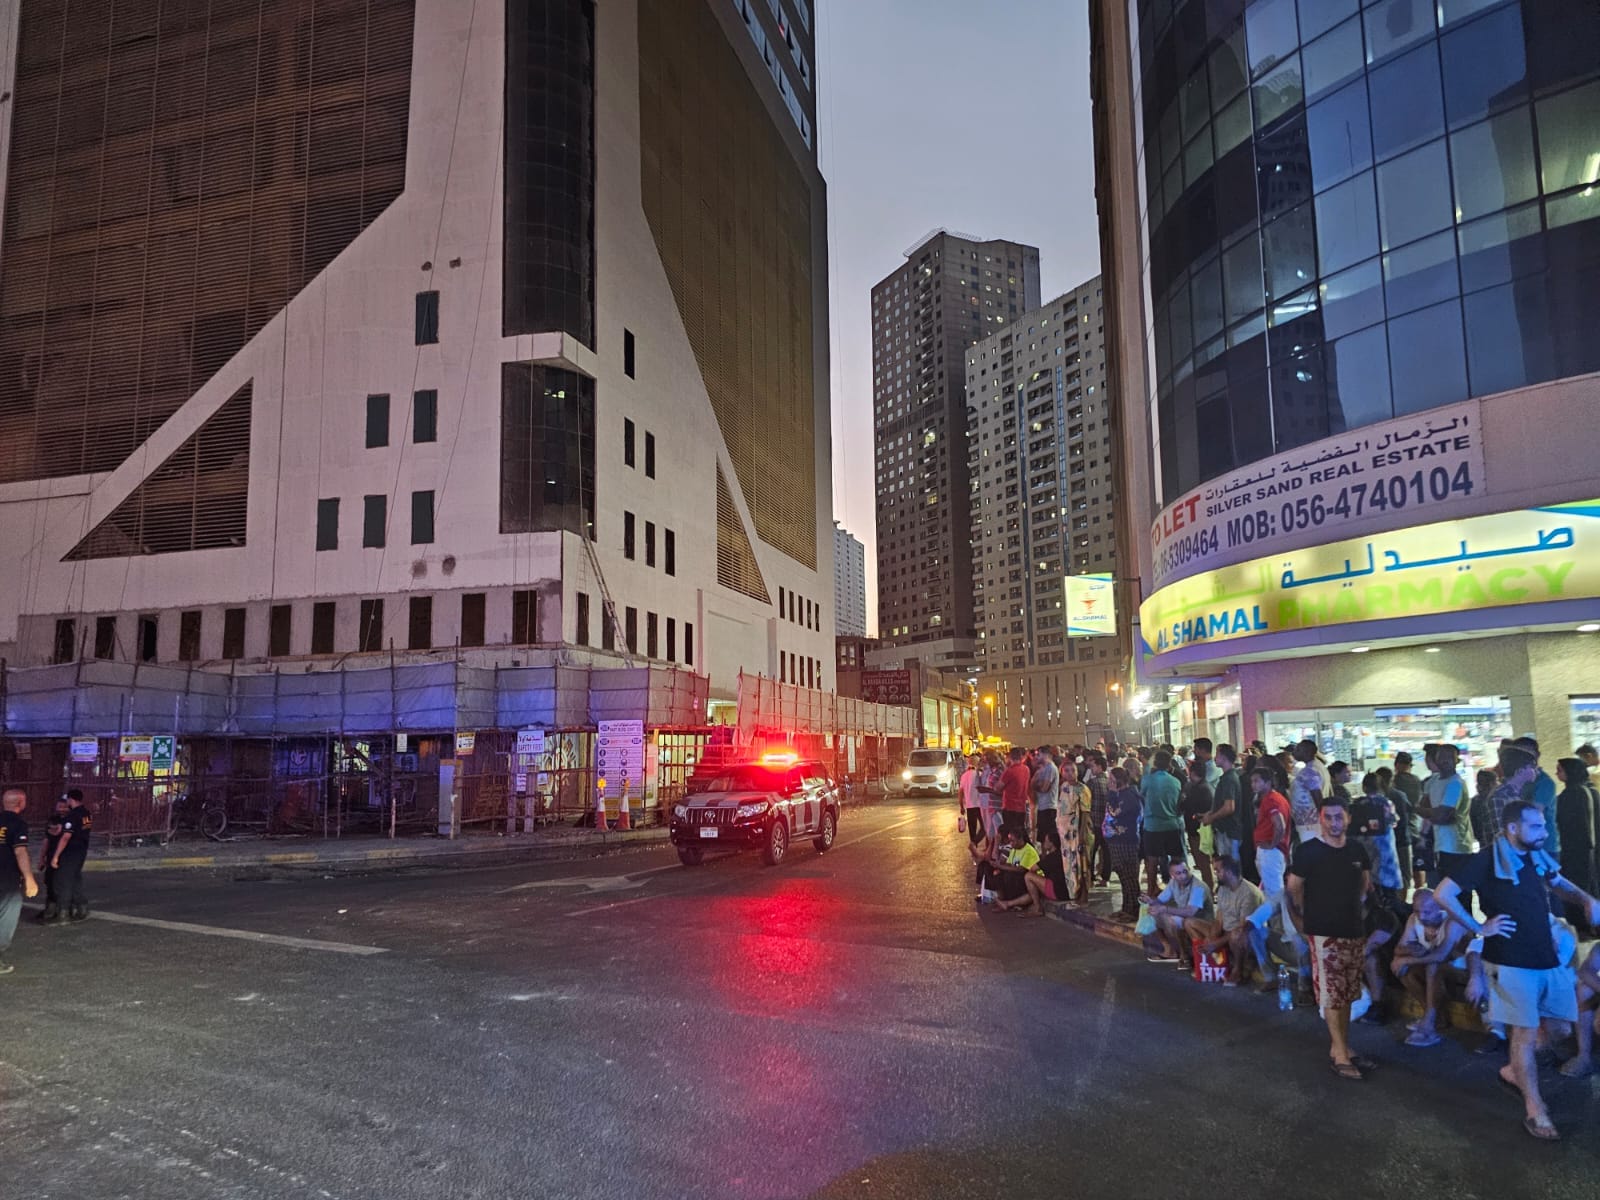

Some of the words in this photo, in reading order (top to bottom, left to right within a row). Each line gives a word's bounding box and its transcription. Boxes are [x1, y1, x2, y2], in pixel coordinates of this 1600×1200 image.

[1205, 467, 1276, 500] للعقارات
[1206, 493, 1251, 518] SILVER
[1256, 477, 1303, 500] SAND
[1310, 461, 1364, 485] REAL
[1372, 435, 1471, 468] ESTATE
[1227, 509, 1276, 548] MOB:
[1280, 461, 1474, 533] 056-4740104
[1163, 494, 1201, 538] LET
[1281, 526, 1575, 589] صيدلية
[1157, 628, 1168, 650] AL
[1172, 604, 1269, 646] SHAMAL
[1279, 561, 1576, 627] PHARMACY
[1199, 966, 1227, 982] HK
